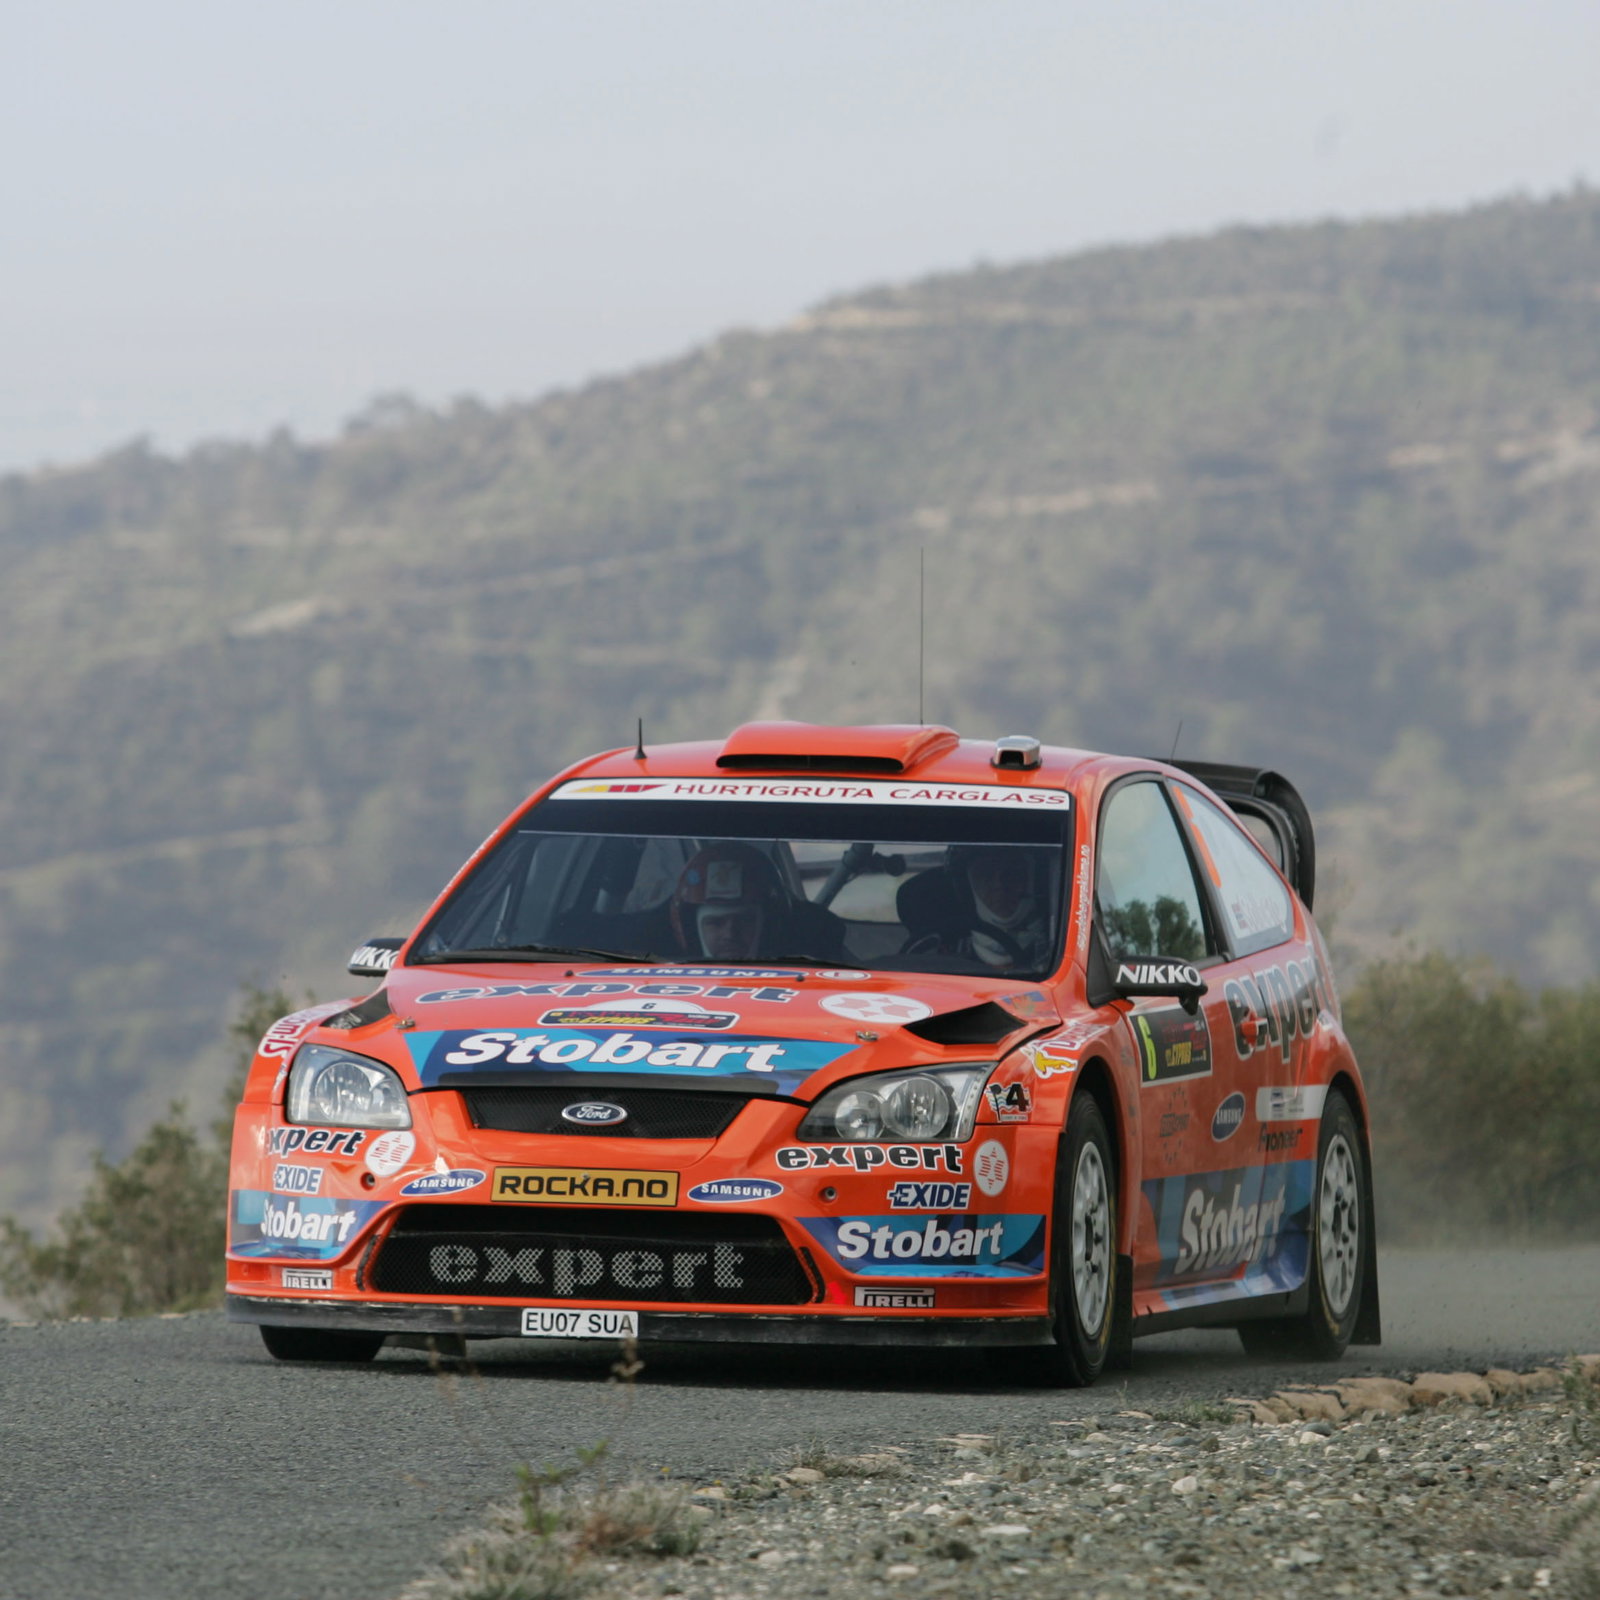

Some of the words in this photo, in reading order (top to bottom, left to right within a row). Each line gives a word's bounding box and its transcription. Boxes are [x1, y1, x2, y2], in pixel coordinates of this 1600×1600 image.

[674, 784, 874, 799] HURTIGRUTA
[890, 788, 1066, 805] CARGLASS
[610, 967, 779, 977] SAMSUNG
[1115, 965, 1201, 986] NIKKO
[415, 983, 800, 1004] expert
[445, 1032, 786, 1072] Stobart
[1137, 1016, 1157, 1079] 6
[576, 1105, 611, 1121] Ford
[1216, 1105, 1244, 1125] SAMSUNG
[776, 1144, 963, 1175] expert
[275, 1164, 323, 1194] EXIDE
[412, 1177, 475, 1189] SAMSUNG
[701, 1184, 772, 1197] SAMSUNG
[888, 1183, 970, 1208] EXIDE
[837, 1220, 1003, 1259] Stobart
[1174, 1183, 1286, 1274] Stobart
[282, 1269, 332, 1290] PIRELLI
[429, 1242, 745, 1296] expert
[855, 1286, 935, 1308] PIRELLI
[525, 1312, 581, 1333] EU07
[587, 1313, 635, 1334] SUA
